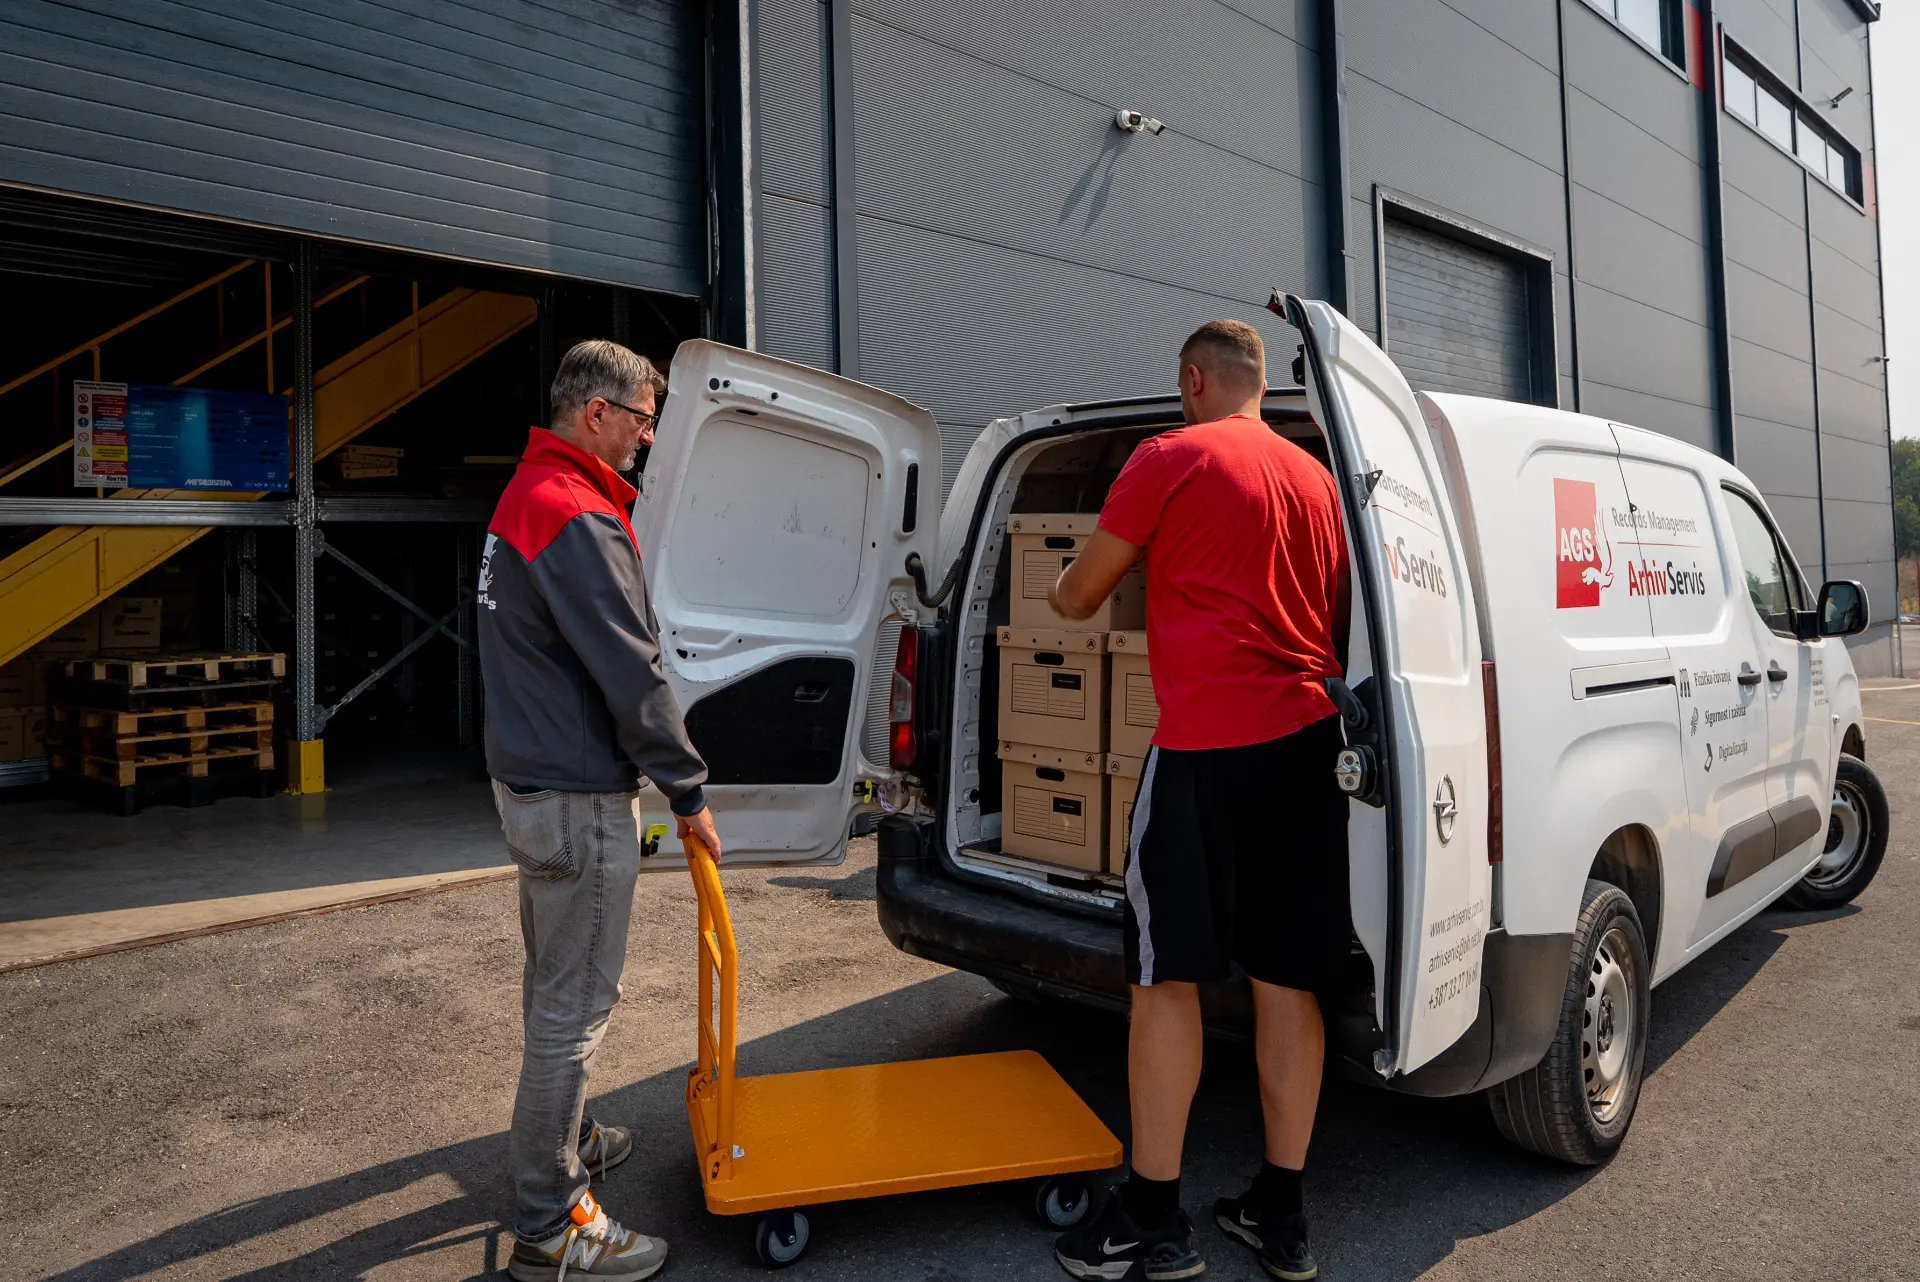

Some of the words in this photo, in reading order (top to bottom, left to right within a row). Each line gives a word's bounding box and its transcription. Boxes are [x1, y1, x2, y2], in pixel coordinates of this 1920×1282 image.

[1611, 507, 1648, 529] Records
[1647, 511, 1697, 536] Management
[1560, 527, 1595, 562] AGS
[1628, 559, 1705, 597] ArhivServis
[1704, 709, 1728, 727] Sigurnost
[1718, 740, 1747, 761] Digitalizacija
[1428, 981, 1448, 1010] +387
[1448, 976, 1457, 1000] 33
[1457, 970, 1465, 994] 27
